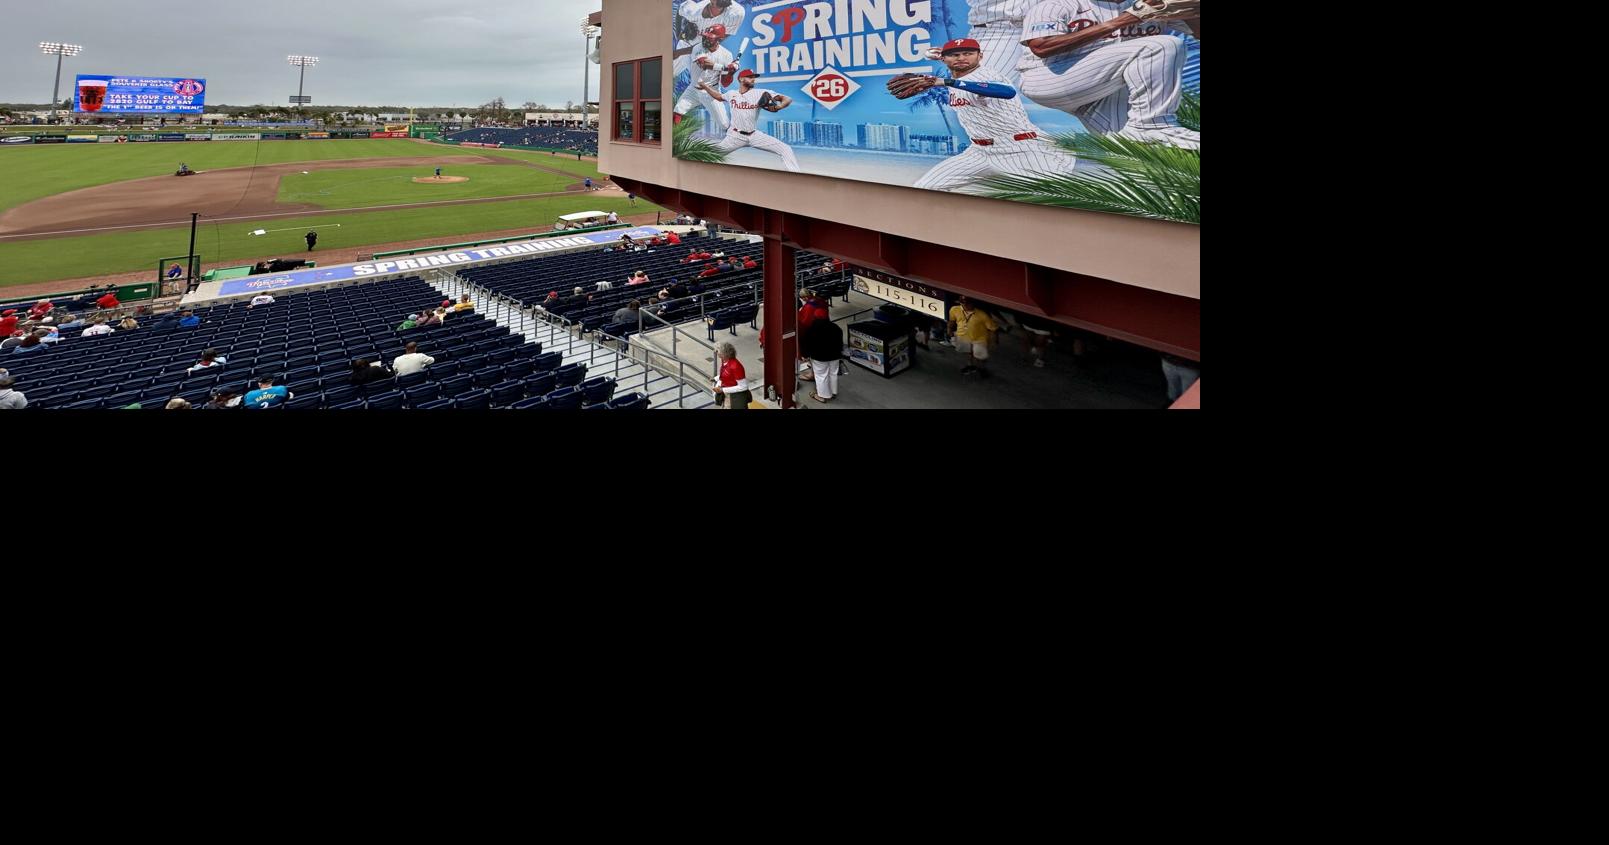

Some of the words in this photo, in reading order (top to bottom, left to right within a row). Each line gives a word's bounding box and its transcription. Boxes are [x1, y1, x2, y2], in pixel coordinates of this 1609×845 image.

[751, 0, 932, 47] SPRING
[752, 27, 931, 74] TRAINING
[352, 252, 471, 276] SPRING
[472, 237, 594, 257] TRAINING
[857, 268, 938, 297] SECTIONS
[875, 284, 938, 312] 115-116
